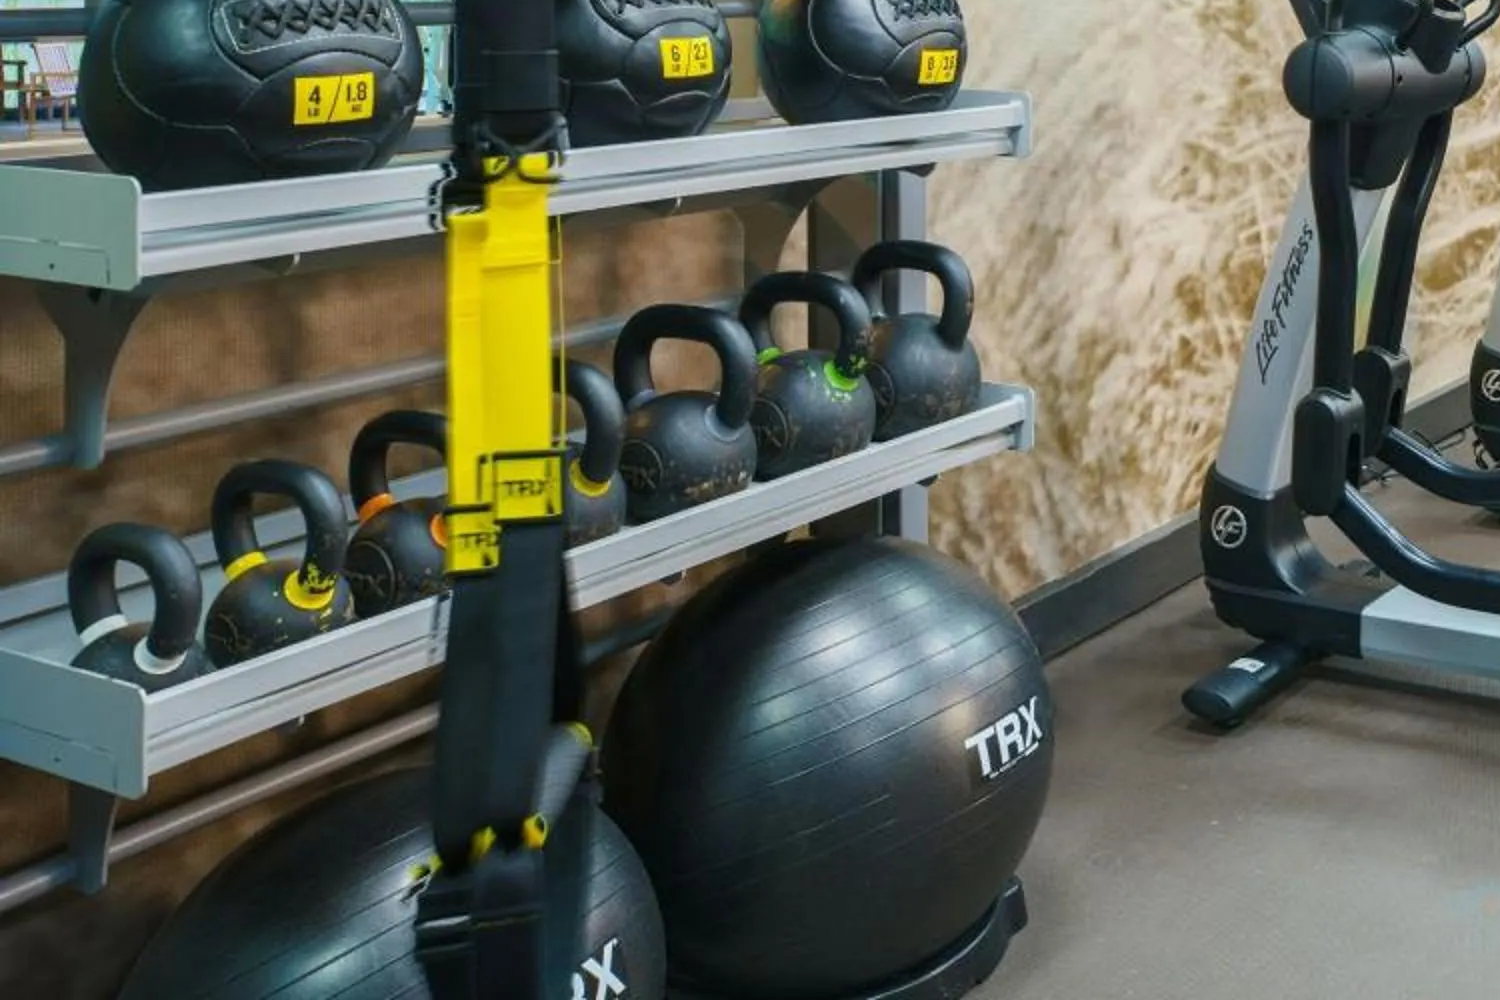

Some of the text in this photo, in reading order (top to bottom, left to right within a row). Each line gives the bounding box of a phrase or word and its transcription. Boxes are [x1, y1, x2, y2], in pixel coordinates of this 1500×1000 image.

[308, 80, 368, 105] 4 1.8
[964, 696, 1043, 777] TRX
